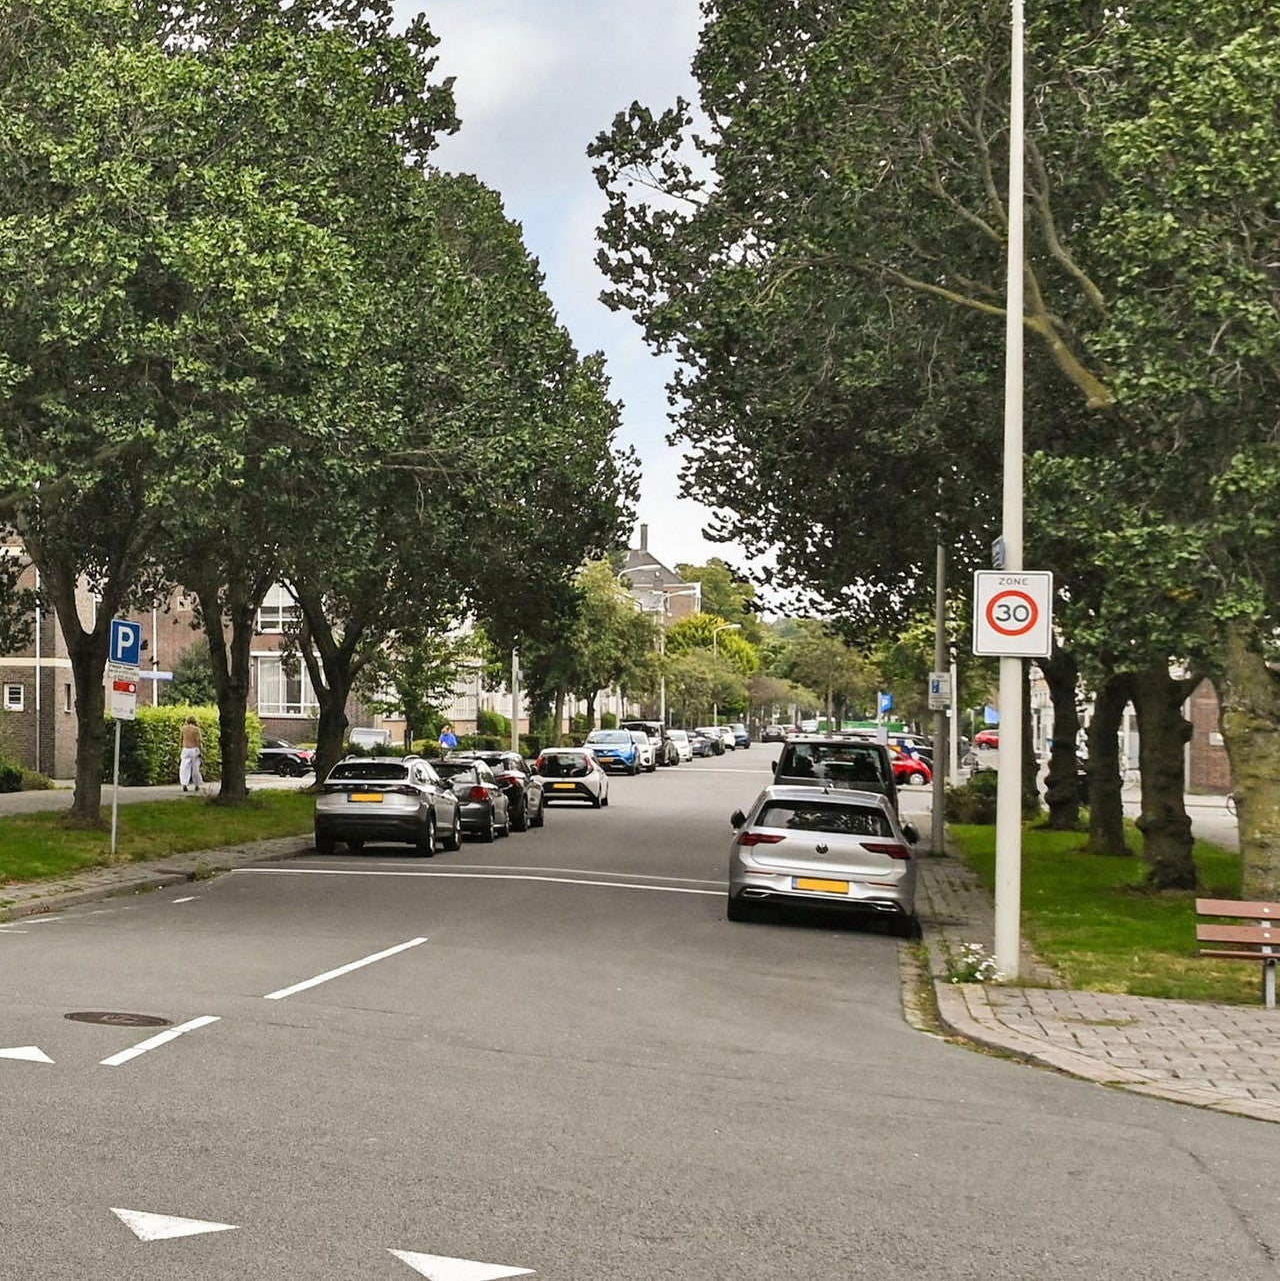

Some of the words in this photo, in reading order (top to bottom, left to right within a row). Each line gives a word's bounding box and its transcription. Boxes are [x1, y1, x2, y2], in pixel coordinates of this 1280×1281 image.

[998, 578, 1028, 586] ZONE
[995, 604, 1030, 622] 30
[117, 626, 135, 658] P
